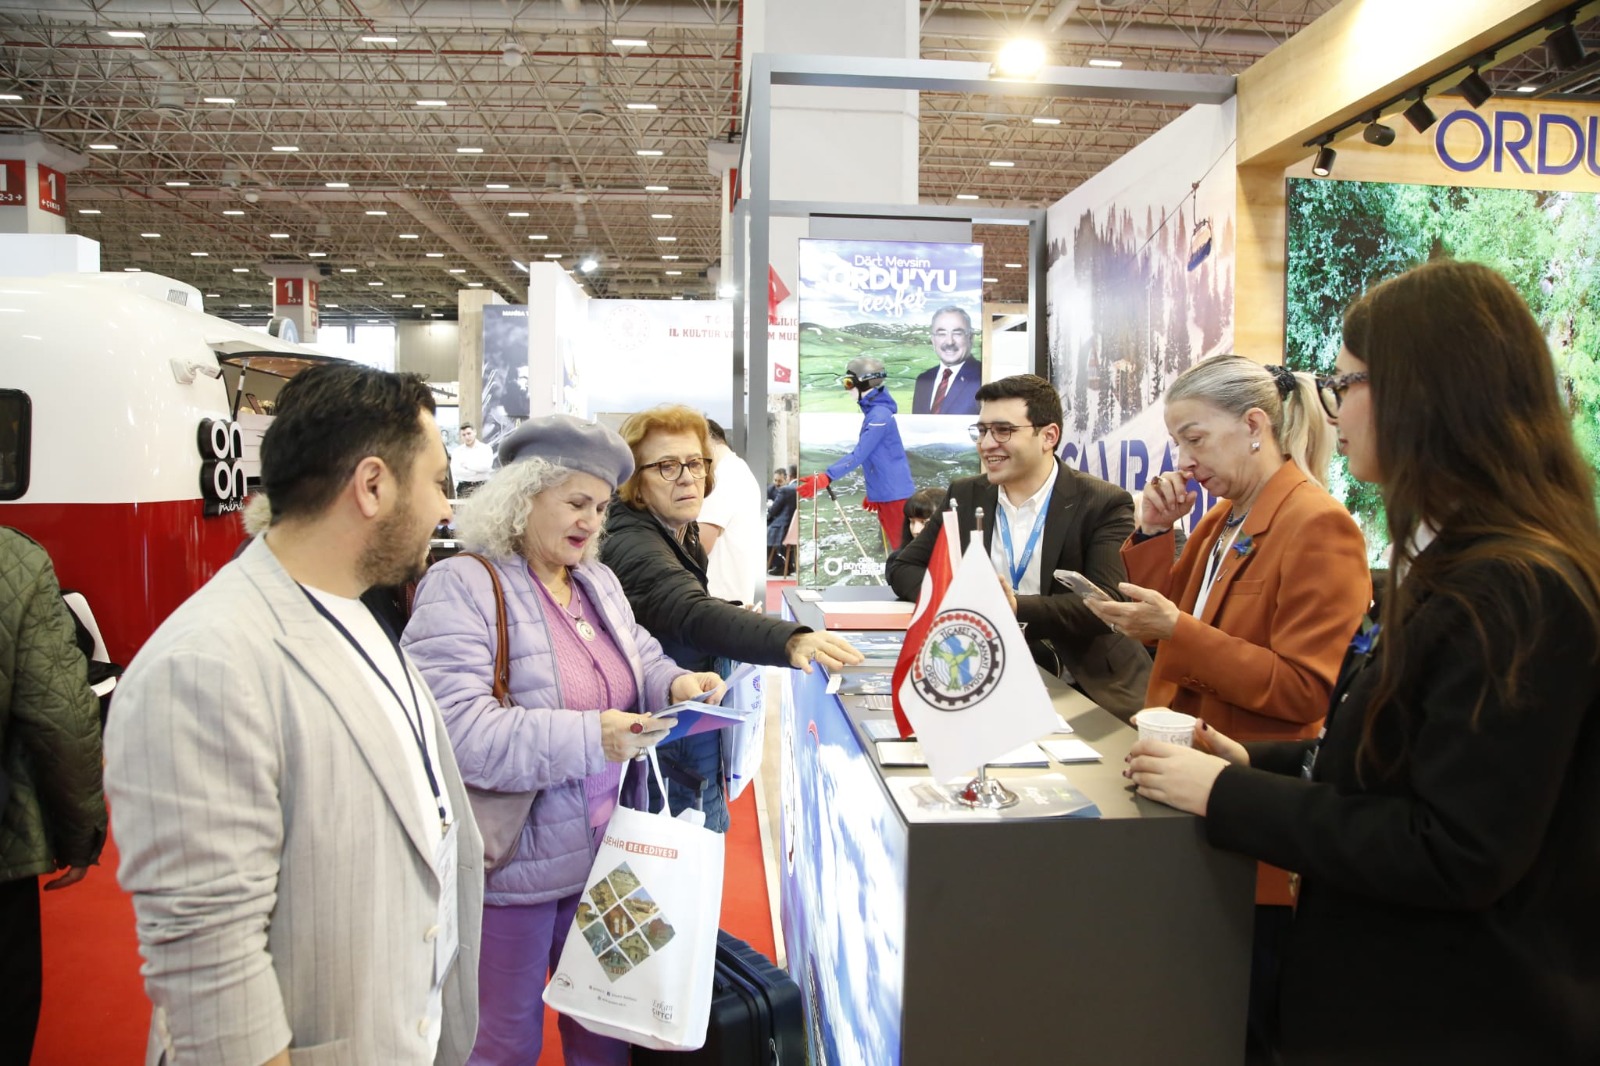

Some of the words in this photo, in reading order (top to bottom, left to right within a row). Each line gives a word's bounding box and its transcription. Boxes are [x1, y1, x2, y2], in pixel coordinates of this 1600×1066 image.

[48, 173, 56, 200] 1
[854, 252, 883, 267] Dört
[885, 255, 931, 268] Mevsim
[285, 280, 293, 298] 1
[828, 267, 957, 292] ORDU'YU
